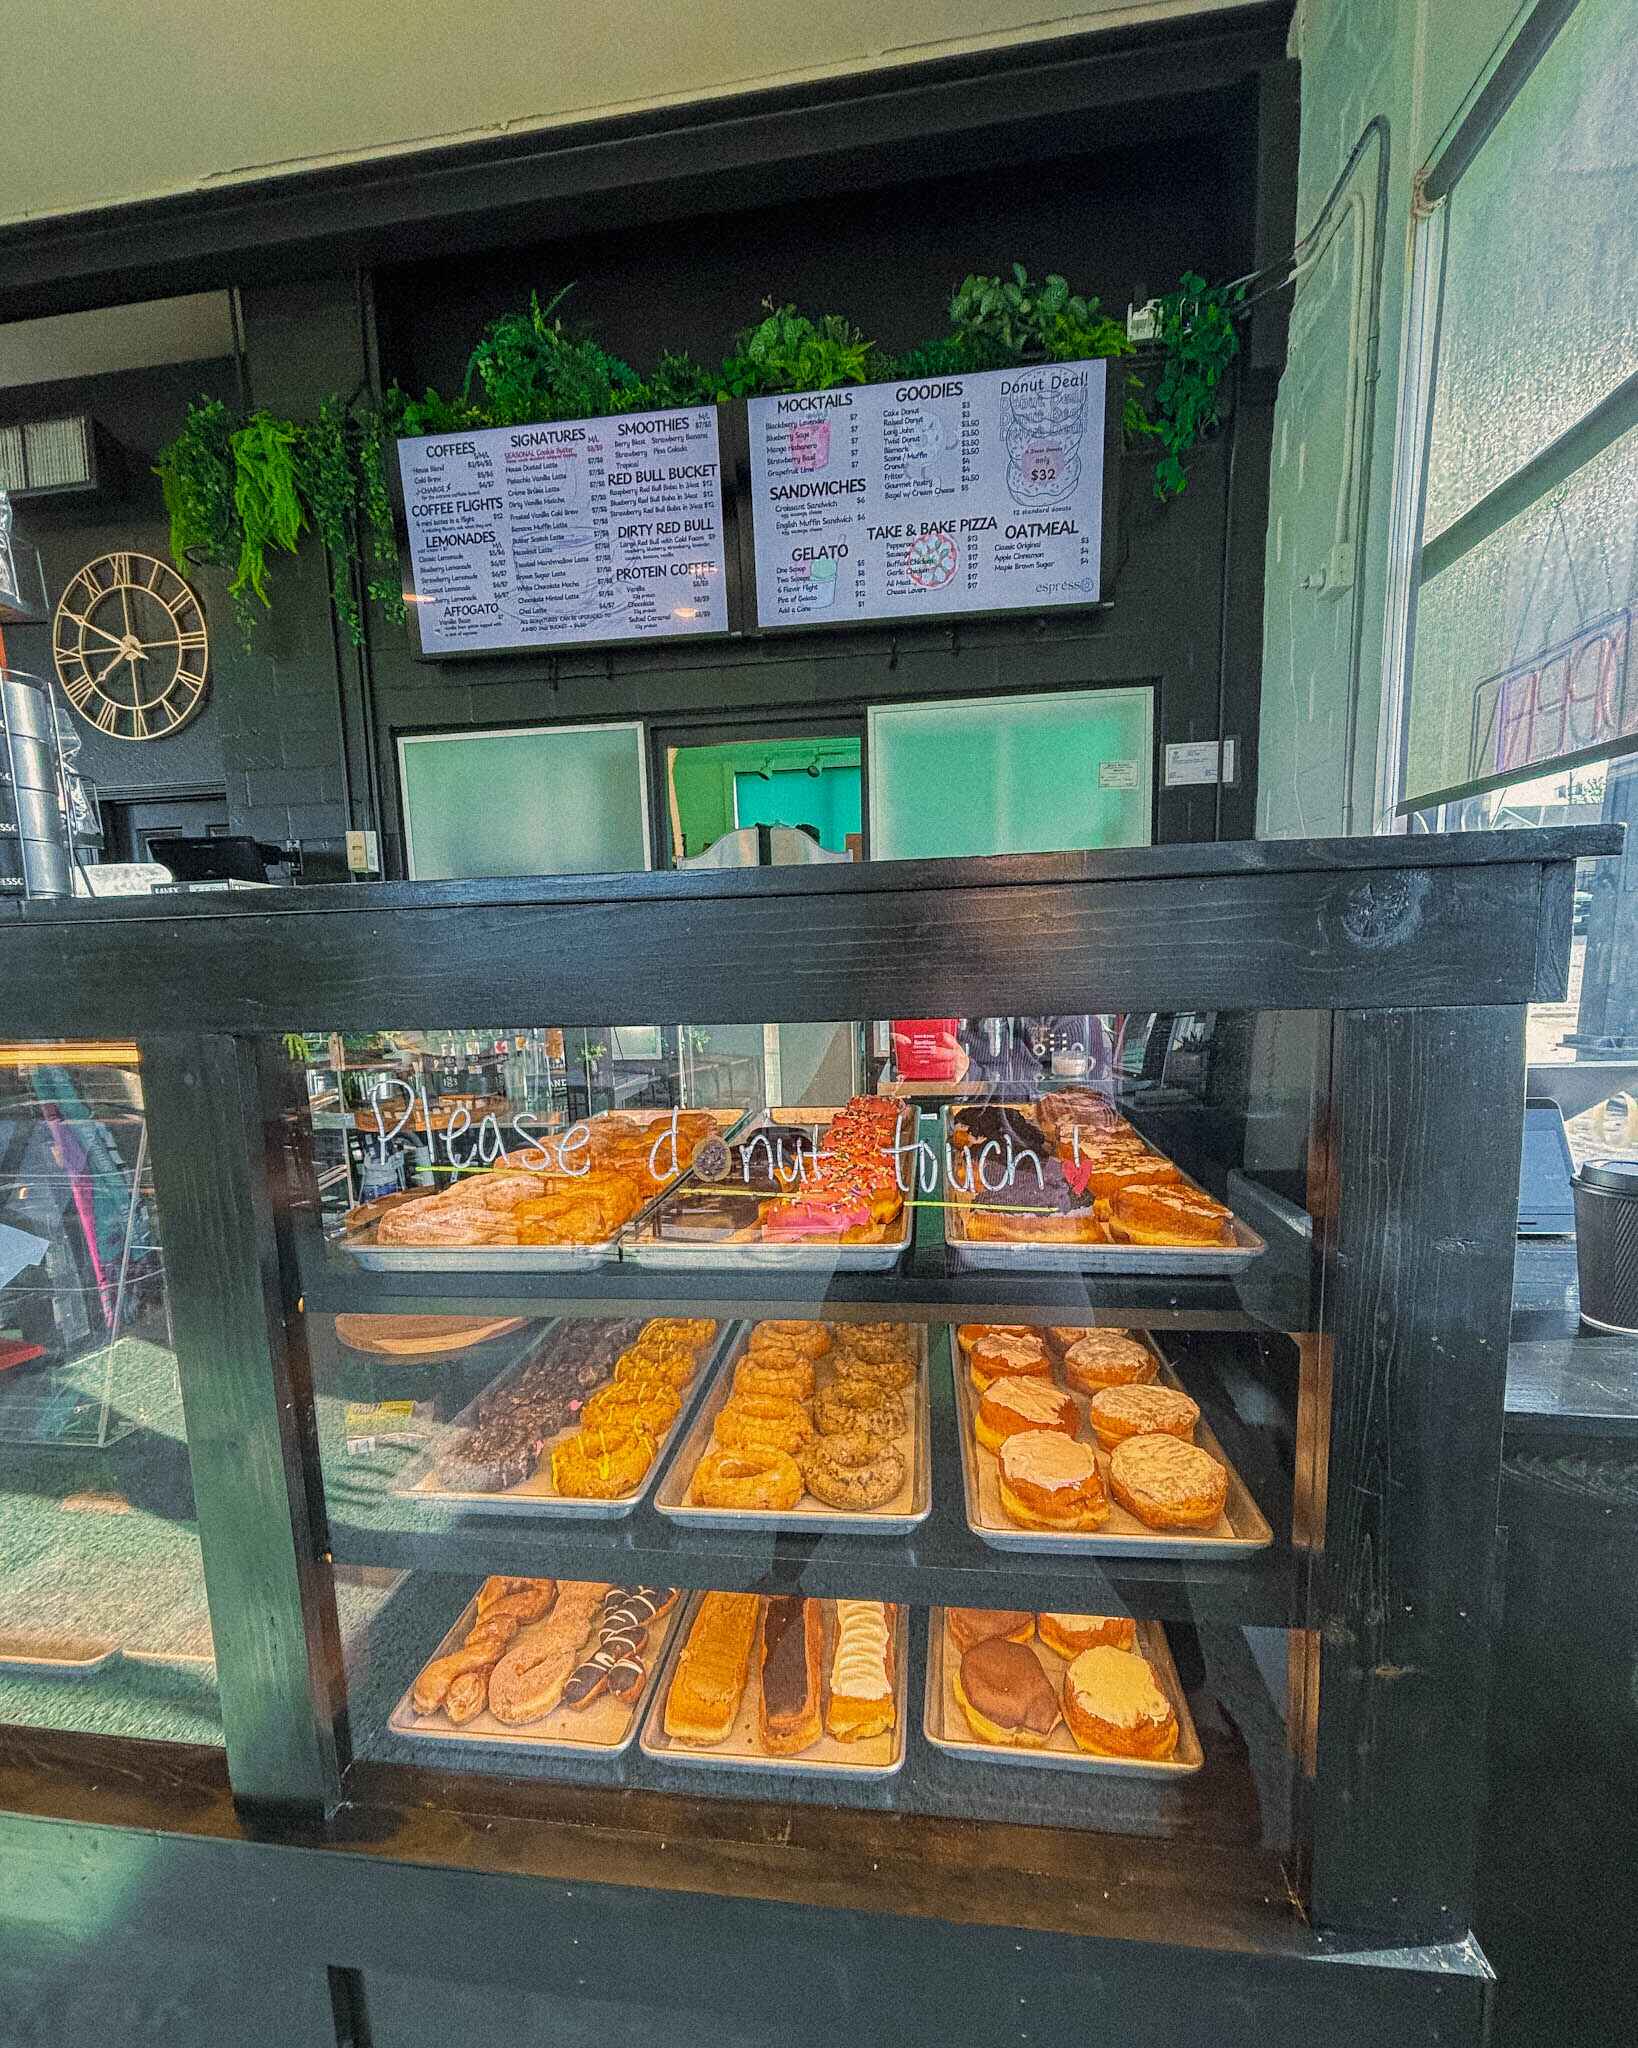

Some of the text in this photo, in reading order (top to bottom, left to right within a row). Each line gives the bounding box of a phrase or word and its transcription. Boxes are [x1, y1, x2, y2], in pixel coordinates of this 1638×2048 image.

[896, 381, 963, 402] GOODIES
[1001, 372, 1088, 395] Donut Deal!
[778, 393, 853, 414] MOCKTAILS
[617, 417, 689, 436] SMOOTHIES
[511, 428, 586, 447] SIGNATURES
[426, 441, 476, 458] COFFEES
[608, 464, 718, 486] RED BULL BUCKET
[1031, 468, 1056, 481] $32
[769, 478, 866, 500] SANDWICHES
[411, 497, 503, 517] COFFEE FLIGHTS
[618, 519, 714, 538] DIRTY RED BULL
[800, 519, 821, 527] Muffin
[867, 516, 997, 540] TAKE & BAKE PIZZA
[1005, 519, 1079, 540] OATMEAL
[426, 531, 496, 548] LEMONADES
[792, 544, 848, 562] GELATO
[616, 565, 666, 580] PROTEIN
[443, 603, 499, 617] AFFOGATO
[366, 1079, 591, 1176] Please
